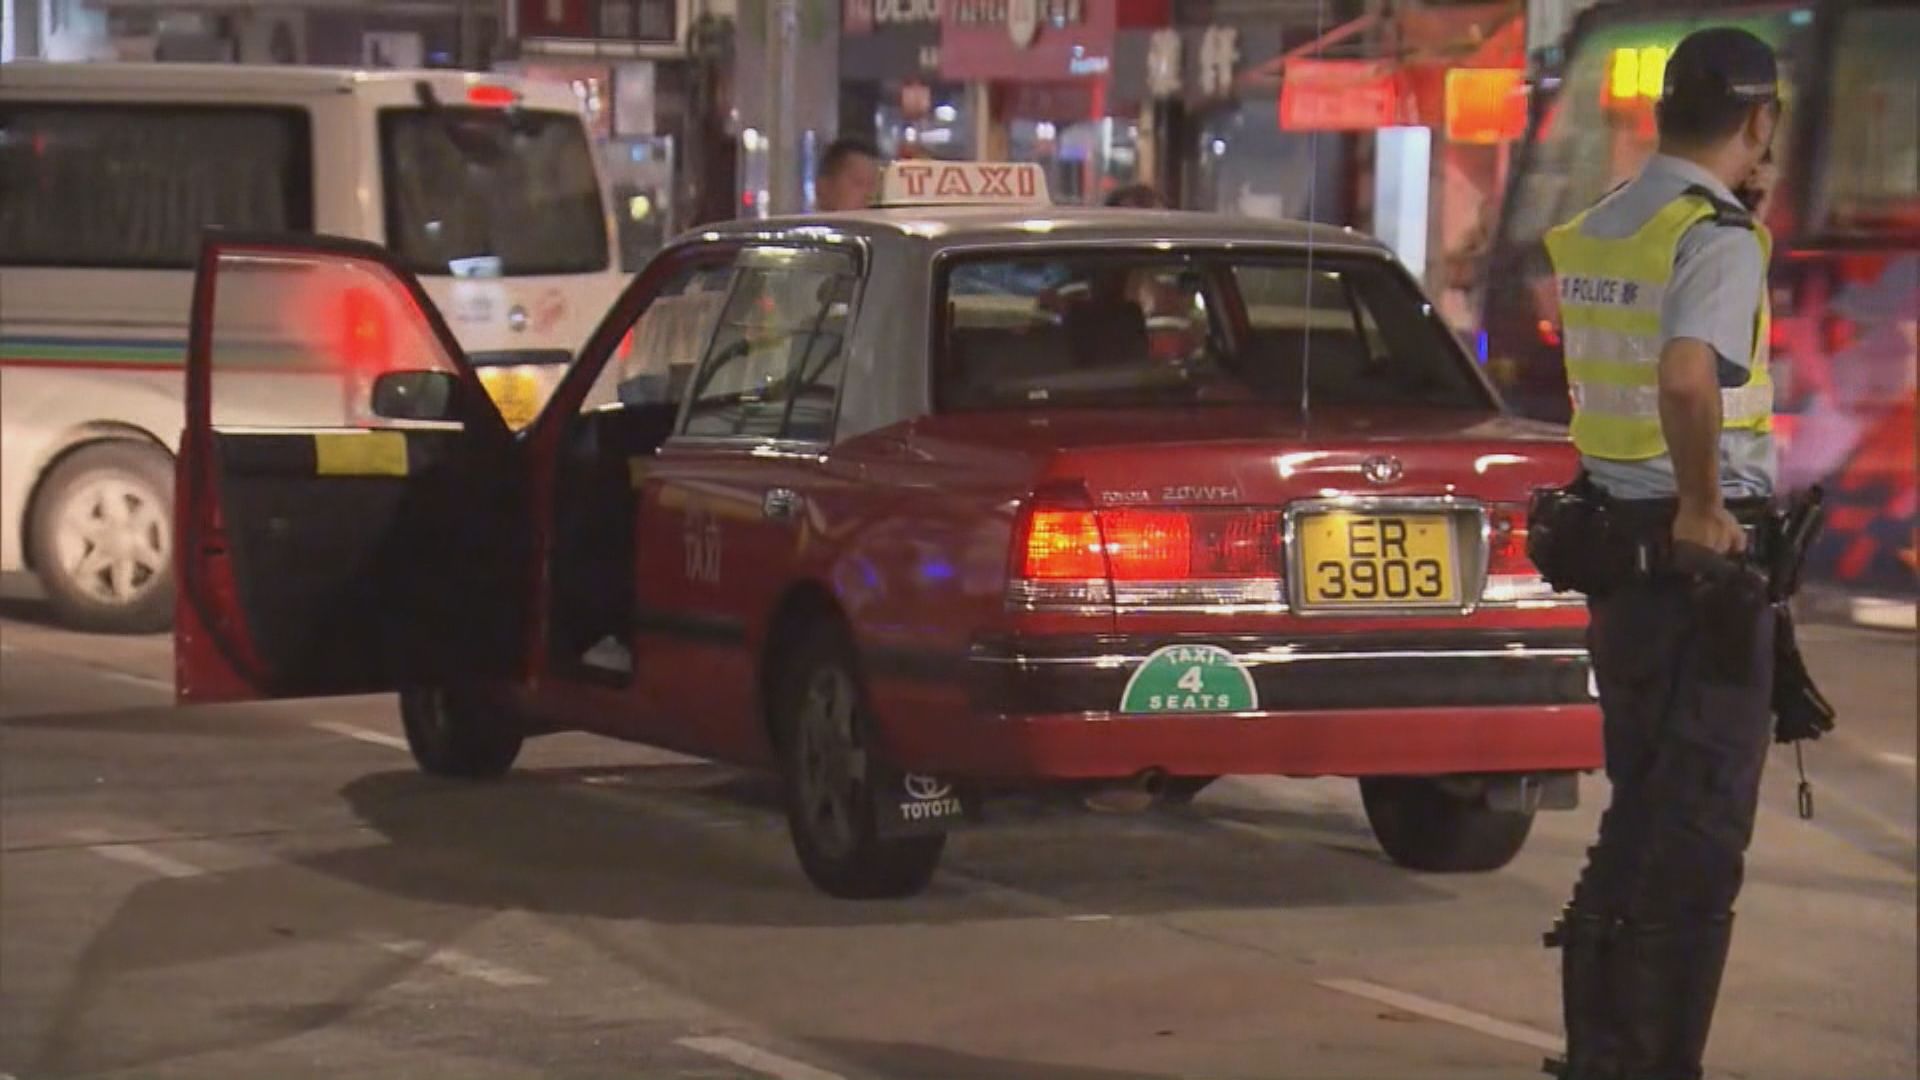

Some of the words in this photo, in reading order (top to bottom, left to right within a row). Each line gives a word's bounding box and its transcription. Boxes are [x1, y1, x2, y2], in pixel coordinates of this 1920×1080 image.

[900, 166, 1035, 196] TAXI
[1571, 278, 1618, 303] POLICE
[1349, 519, 1408, 558] ER
[1318, 559, 1443, 598] 3903
[1165, 648, 1215, 665] TAXI
[1177, 666, 1204, 693] 4
[1149, 695, 1230, 709] SEATS
[900, 799, 962, 819] TOYOTA
